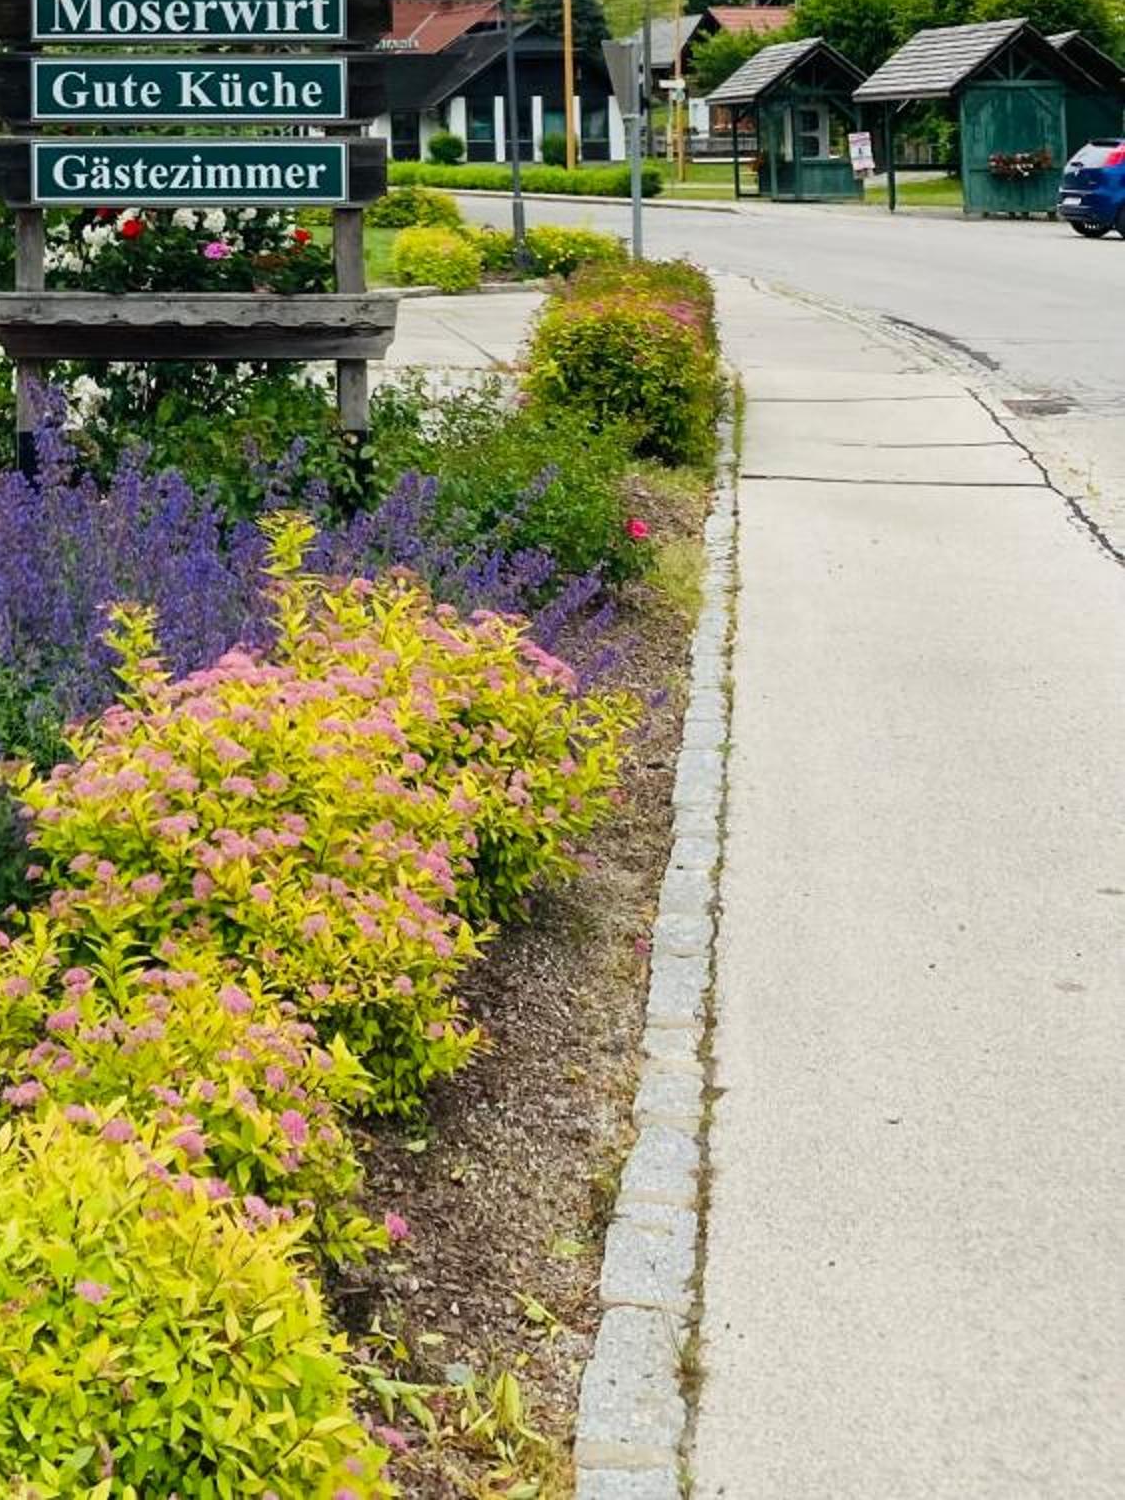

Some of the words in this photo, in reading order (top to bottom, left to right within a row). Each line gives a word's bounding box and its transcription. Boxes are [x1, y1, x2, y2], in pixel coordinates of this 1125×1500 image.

[52, 71, 161, 109] Gute
[177, 71, 323, 108] Küche
[52, 155, 326, 190] Gästezimmer
